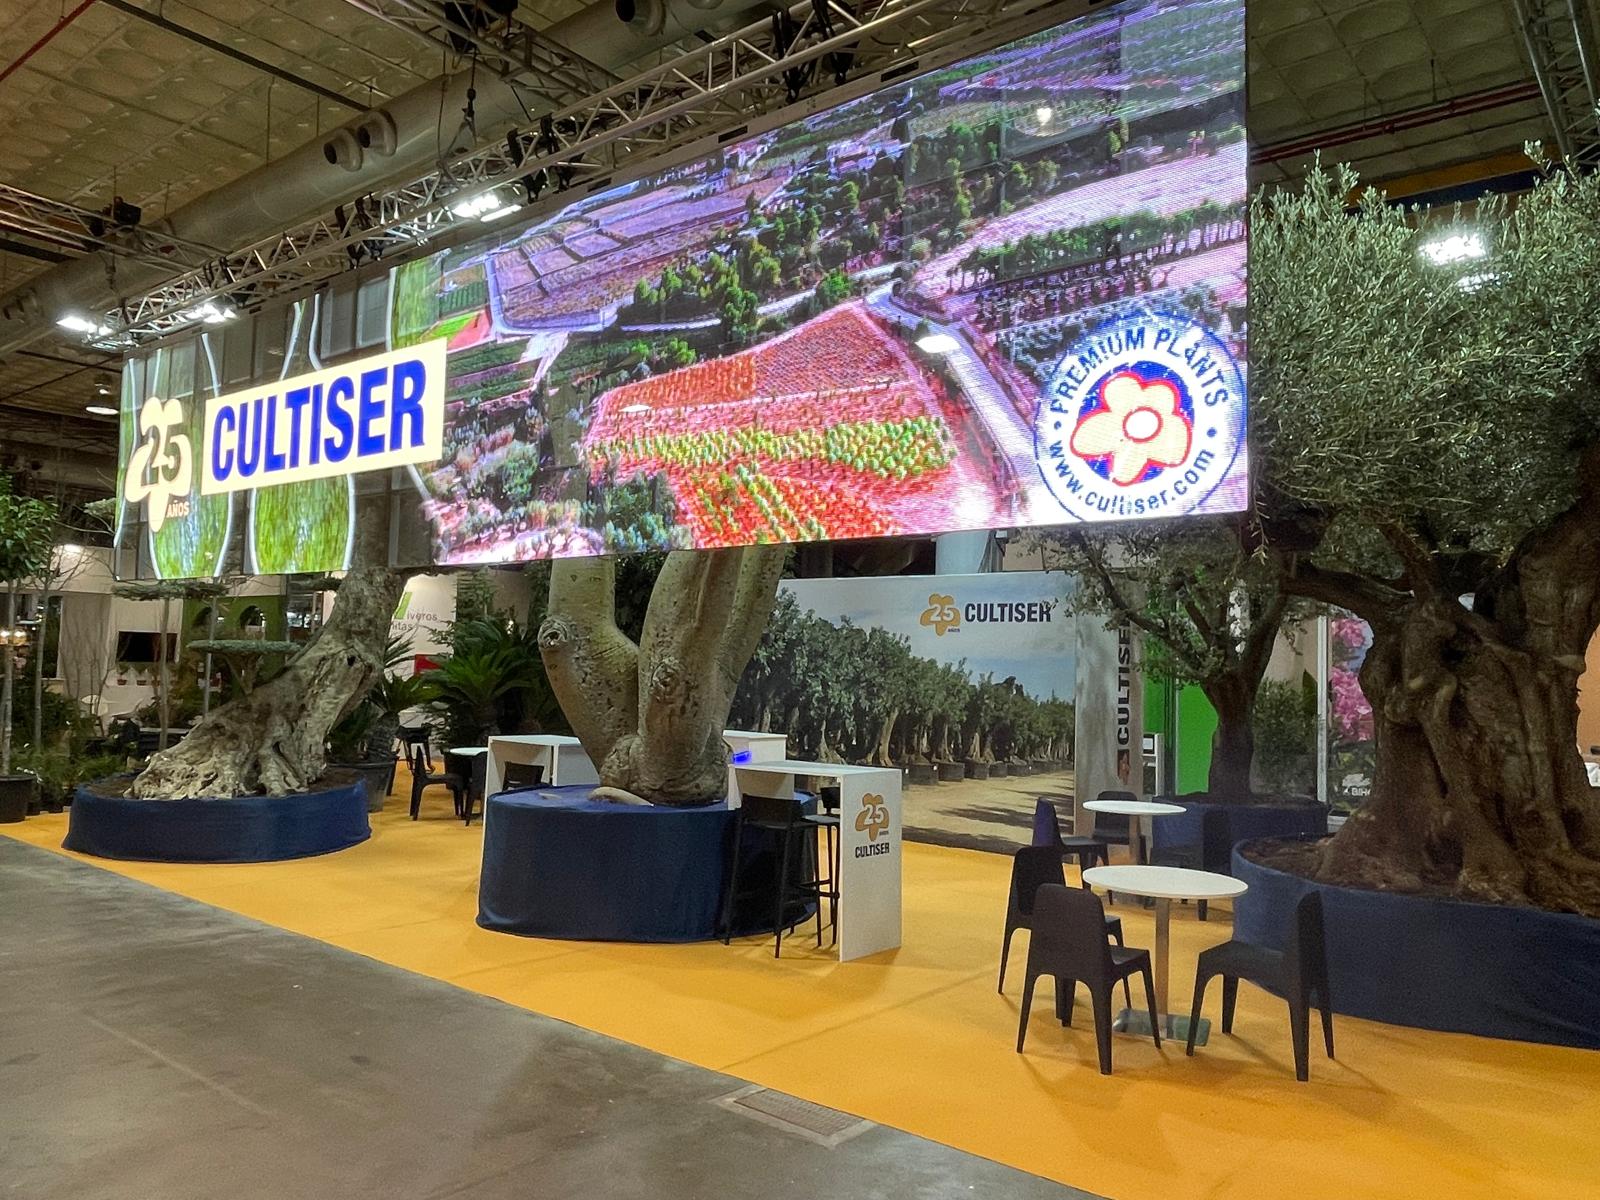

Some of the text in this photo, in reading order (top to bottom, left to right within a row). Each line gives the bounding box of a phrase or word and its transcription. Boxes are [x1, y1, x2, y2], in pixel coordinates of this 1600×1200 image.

[1050, 326, 1229, 415] PREMIUM PLANTS
[211, 359, 427, 482] CULTISER
[140, 423, 184, 487] 25
[166, 500, 190, 518] AÑOS
[930, 604, 955, 622] 25
[964, 602, 1052, 623] CULTISER
[863, 803, 885, 826] 25
[855, 842, 890, 858] CULTISER
